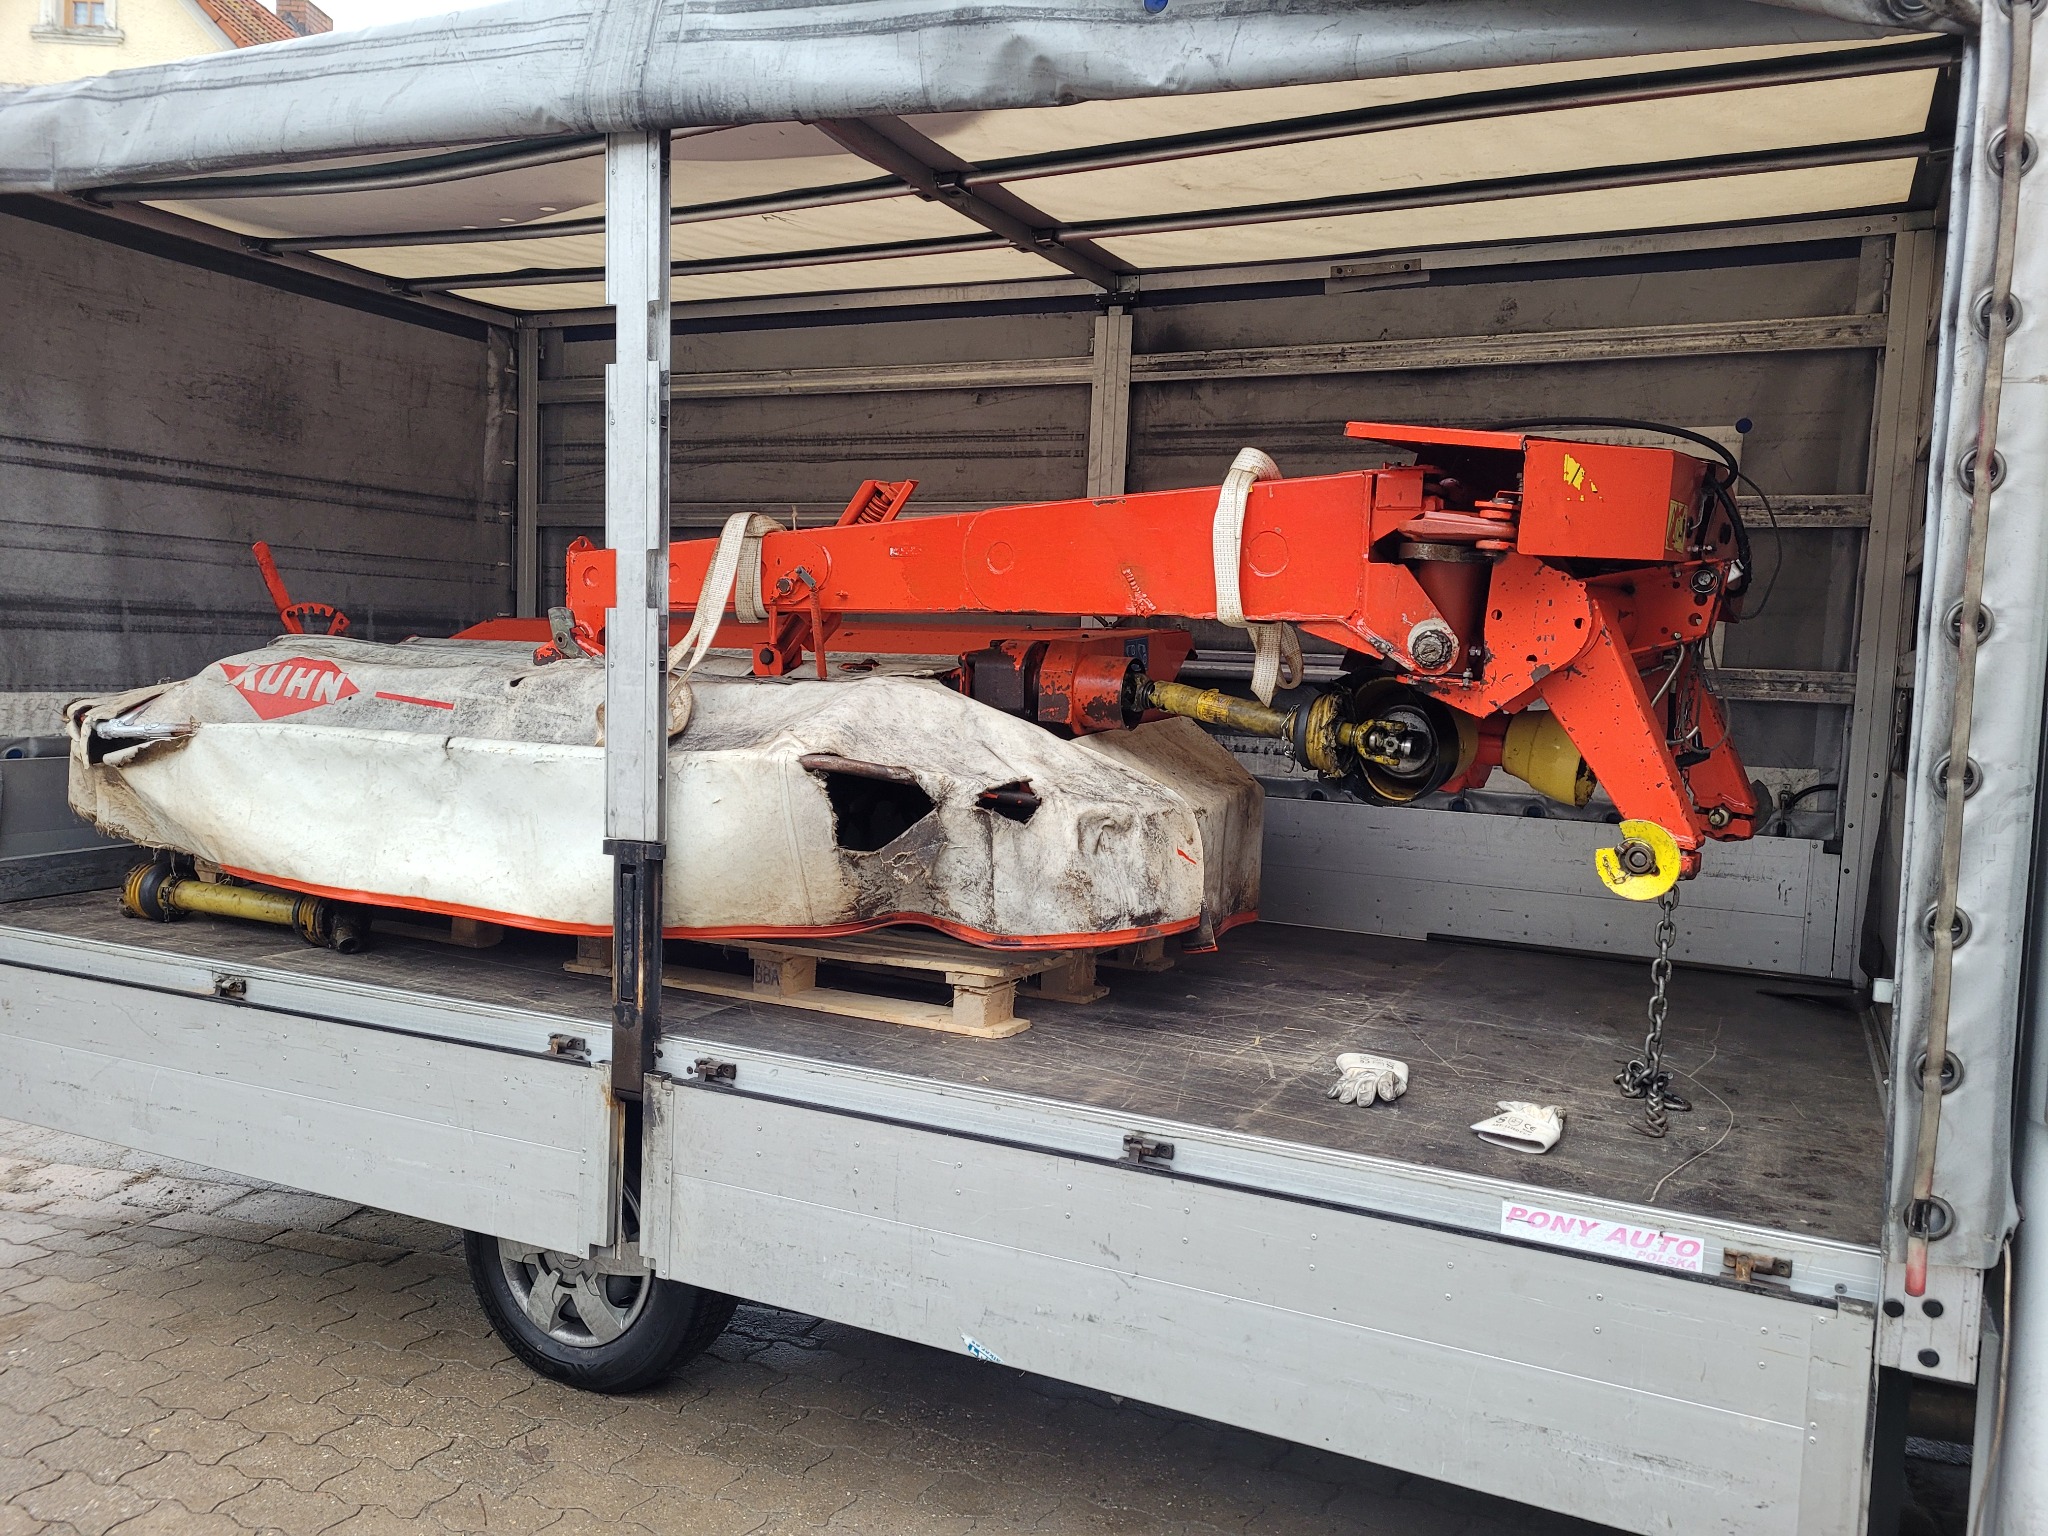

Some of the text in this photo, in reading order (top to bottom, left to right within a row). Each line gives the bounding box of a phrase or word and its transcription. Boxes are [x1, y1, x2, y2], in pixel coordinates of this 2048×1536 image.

[228, 662, 348, 705] KUHN
[1506, 1206, 1701, 1258] PONY AUTO
[1635, 1250, 1697, 1270] POLSKA
